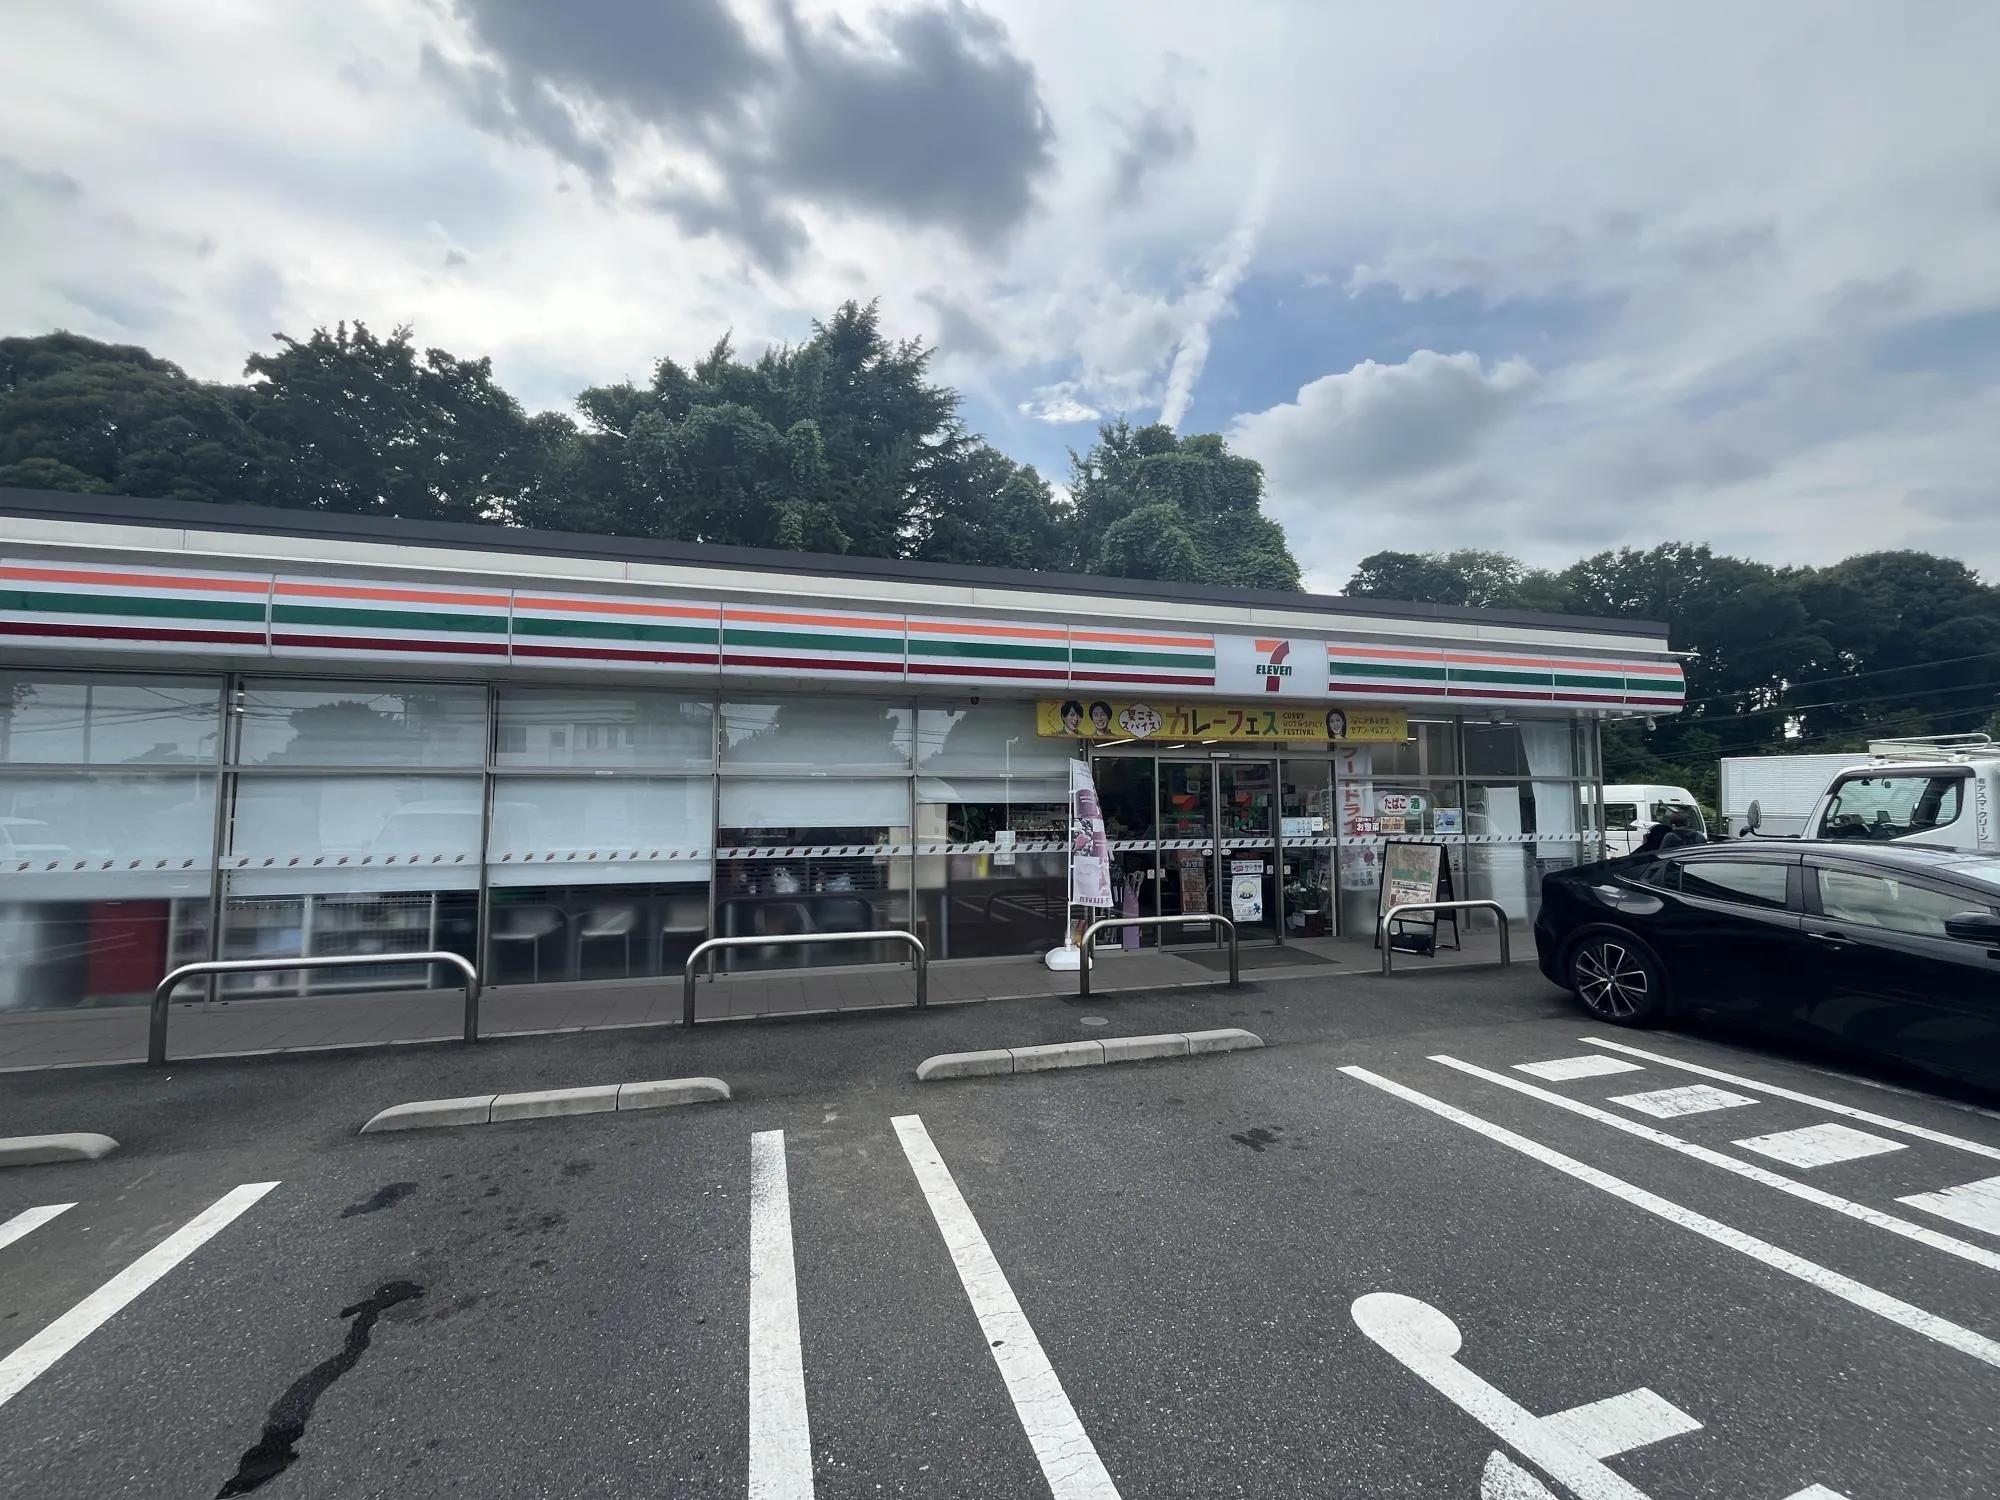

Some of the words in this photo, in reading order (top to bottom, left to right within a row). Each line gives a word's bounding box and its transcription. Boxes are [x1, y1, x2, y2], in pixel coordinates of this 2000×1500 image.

[1254, 639, 1290, 692] 7
[1128, 709, 1154, 721] 夏こそ
[1166, 706, 1279, 736] カレーフェス
[1283, 728, 1315, 736] FESTIVAL
[1384, 798, 1407, 810] たばこ
[1410, 797, 1420, 810] 酒
[1356, 822, 1380, 832] お惣菜
